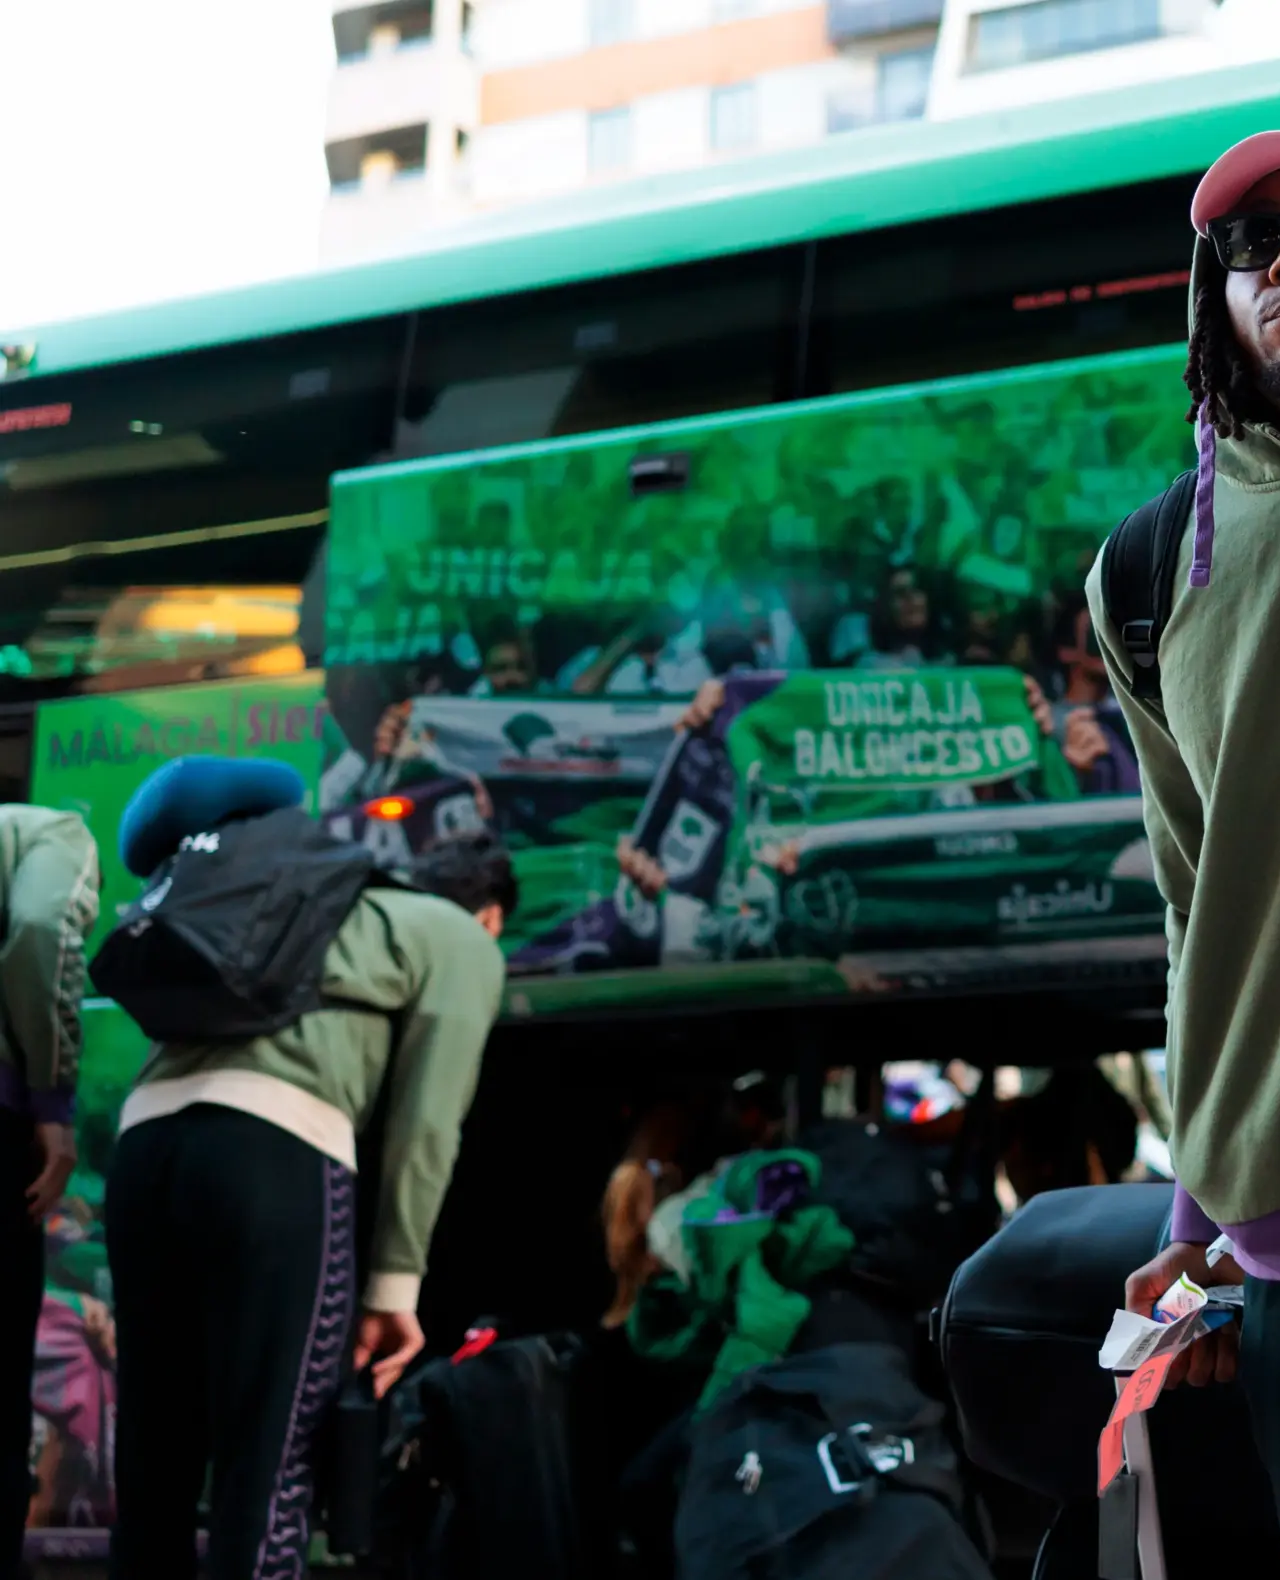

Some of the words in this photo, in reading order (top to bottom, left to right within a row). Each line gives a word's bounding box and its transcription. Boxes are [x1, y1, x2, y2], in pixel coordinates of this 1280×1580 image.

[406, 546, 654, 599] UNICAJA
[824, 680, 983, 726] UNICAJA
[795, 724, 1032, 778] BALONCESTO
